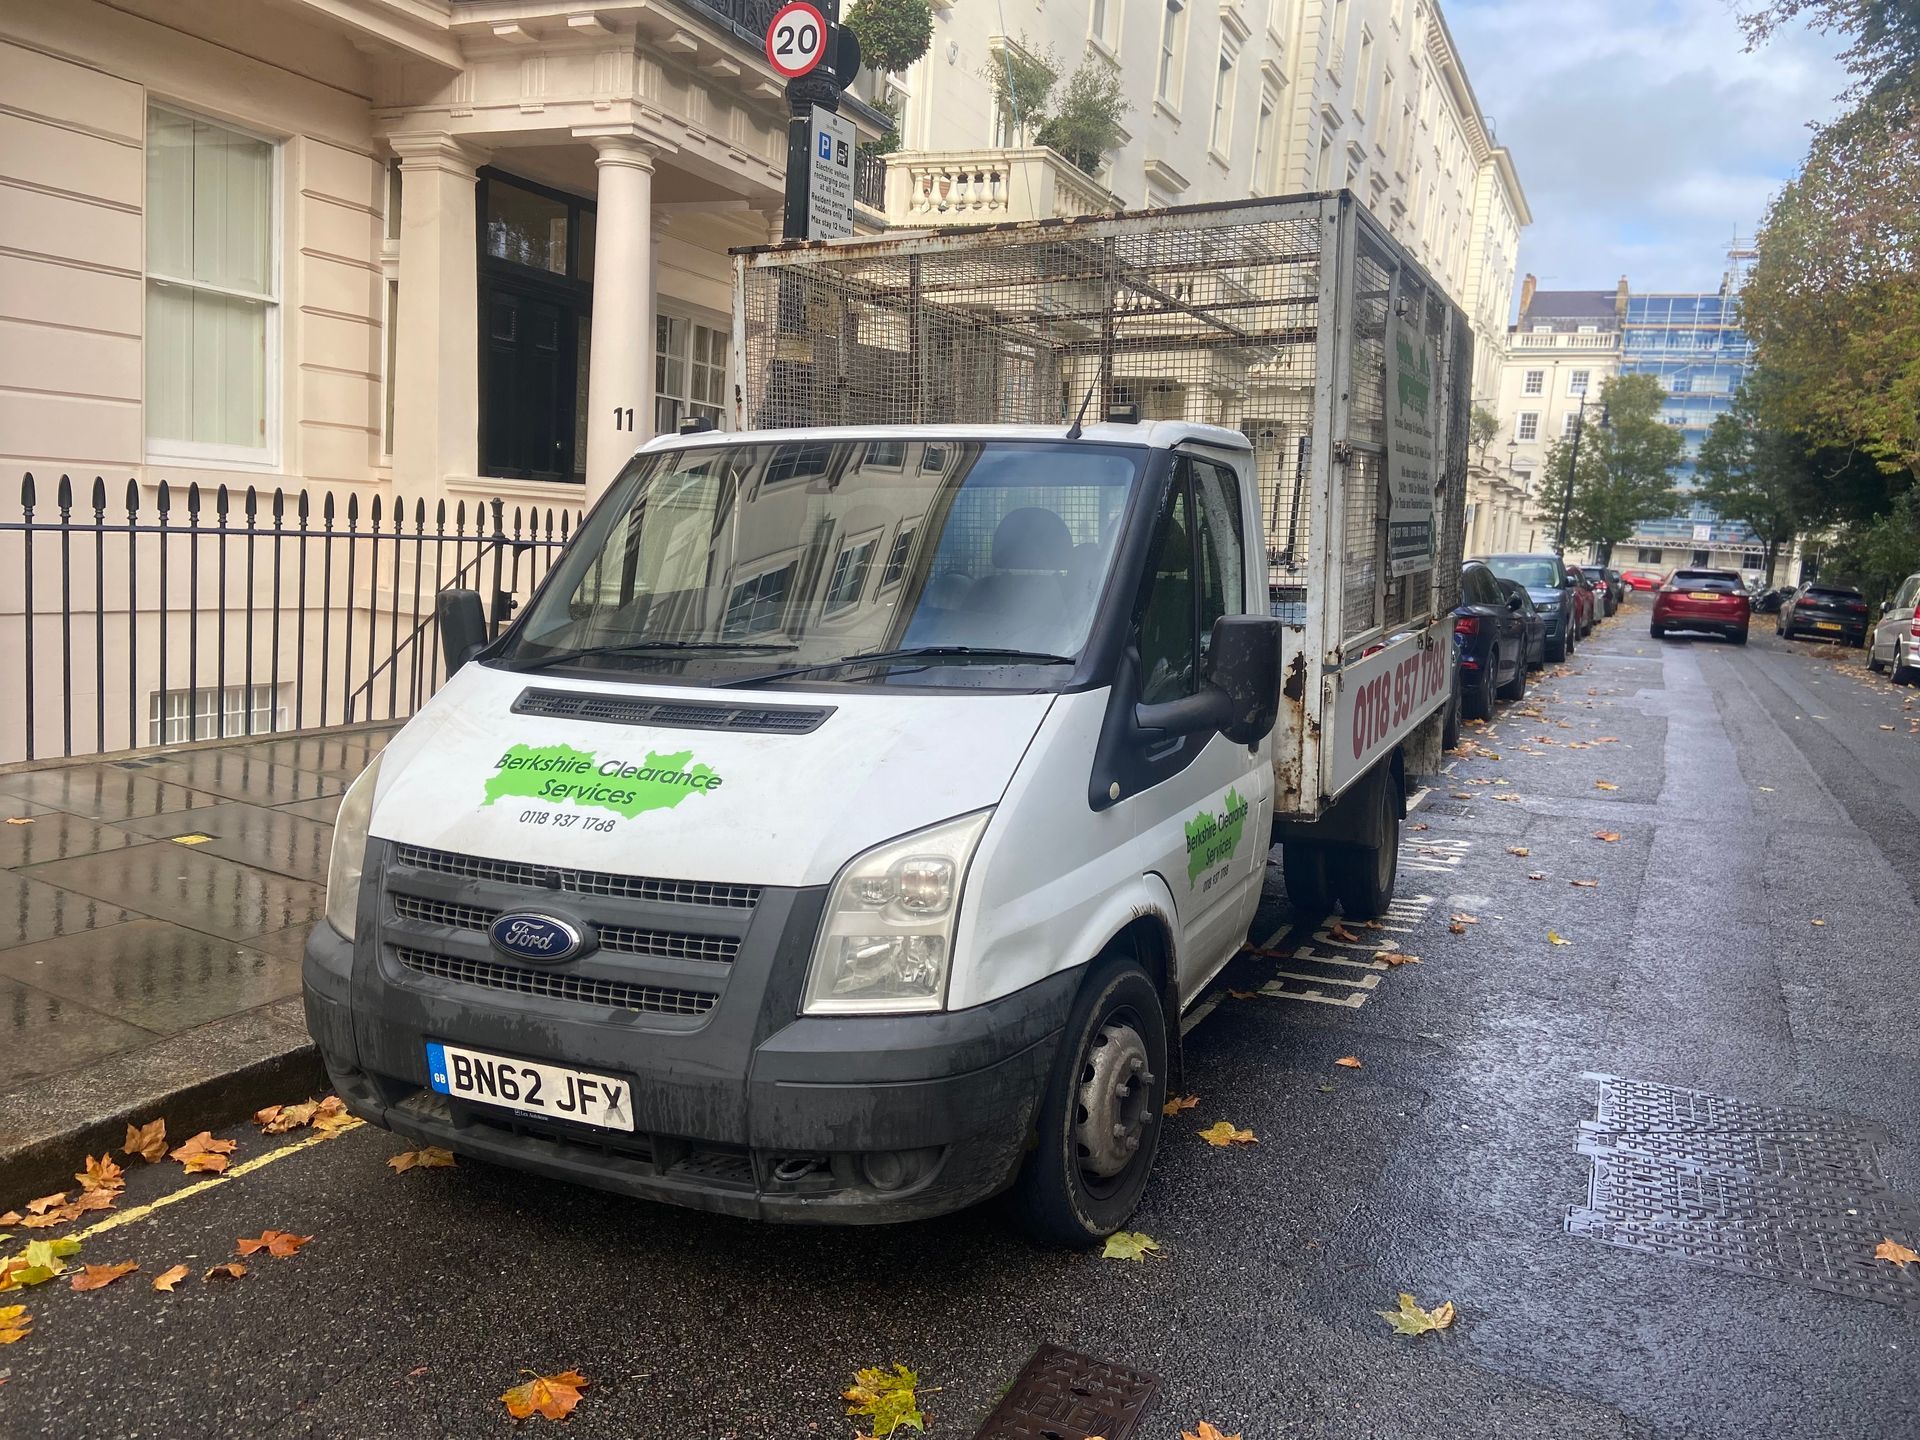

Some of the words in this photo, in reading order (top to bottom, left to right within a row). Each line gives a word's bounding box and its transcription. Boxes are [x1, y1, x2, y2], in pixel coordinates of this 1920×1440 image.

[776, 24, 818, 55] 20
[822, 136, 830, 156] P
[816, 160, 833, 175] Electric
[814, 172, 838, 188] recharging
[820, 183, 825, 191] at
[832, 187, 845, 198] times
[811, 191, 831, 206] Resident
[831, 201, 847, 212] permit
[815, 203, 831, 216] holders
[832, 210, 842, 221] only
[811, 214, 820, 225] Max
[822, 219, 831, 230] stay
[833, 221, 838, 231] 12
[839, 224, 851, 235] hours
[820, 230, 827, 240] No
[613, 407, 634, 432] 11
[1353, 670, 1391, 760] 0118
[1392, 652, 1420, 728] 937
[493, 753, 592, 774] Berkshire
[598, 760, 723, 790] Clearance
[537, 778, 637, 805] Services
[519, 810, 550, 825] 0118
[551, 813, 581, 828] 937
[582, 816, 617, 833] 1768
[1186, 821, 1217, 854] Berkshire
[1217, 801, 1249, 832] Clearance
[1206, 836, 1232, 866] Services
[505, 920, 555, 950] Ford
[433, 1072, 446, 1084] GB
[451, 1054, 545, 1106] BN62
